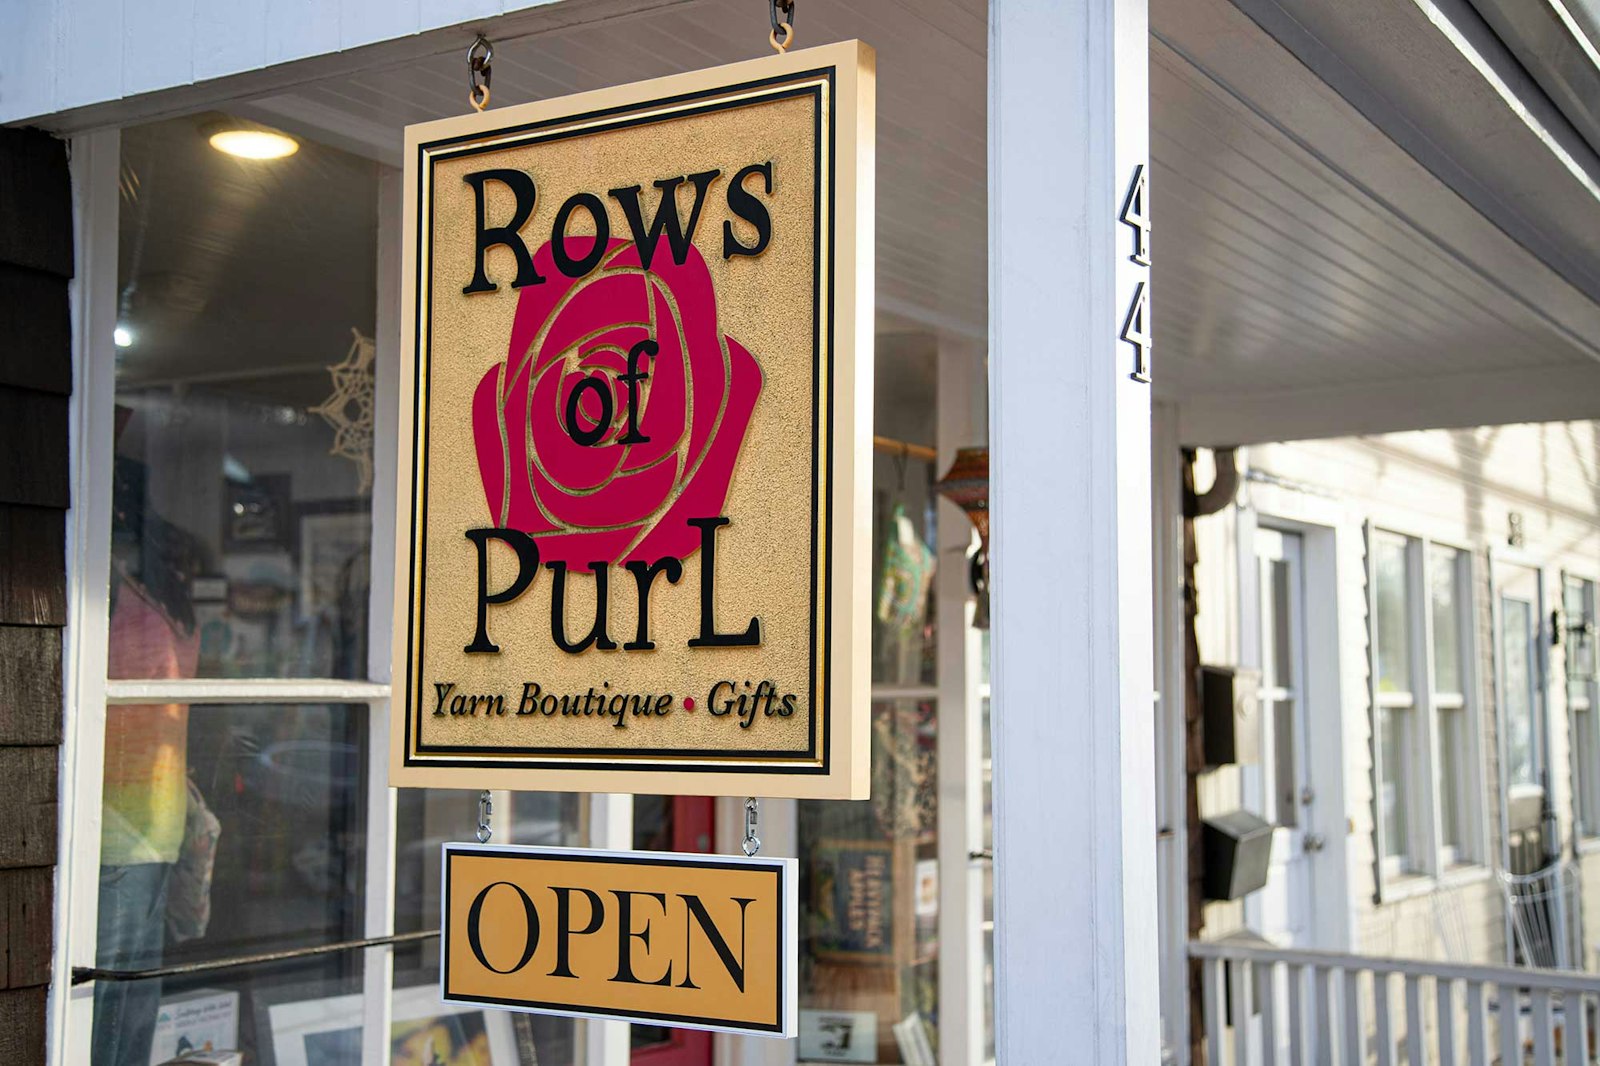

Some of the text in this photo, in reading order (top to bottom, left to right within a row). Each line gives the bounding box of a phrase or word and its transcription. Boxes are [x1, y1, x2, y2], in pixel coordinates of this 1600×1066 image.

[565, 340, 659, 447] of
[432, 680, 797, 729] Yarn Boutique Gifts
[466, 881, 757, 993] OPEN
